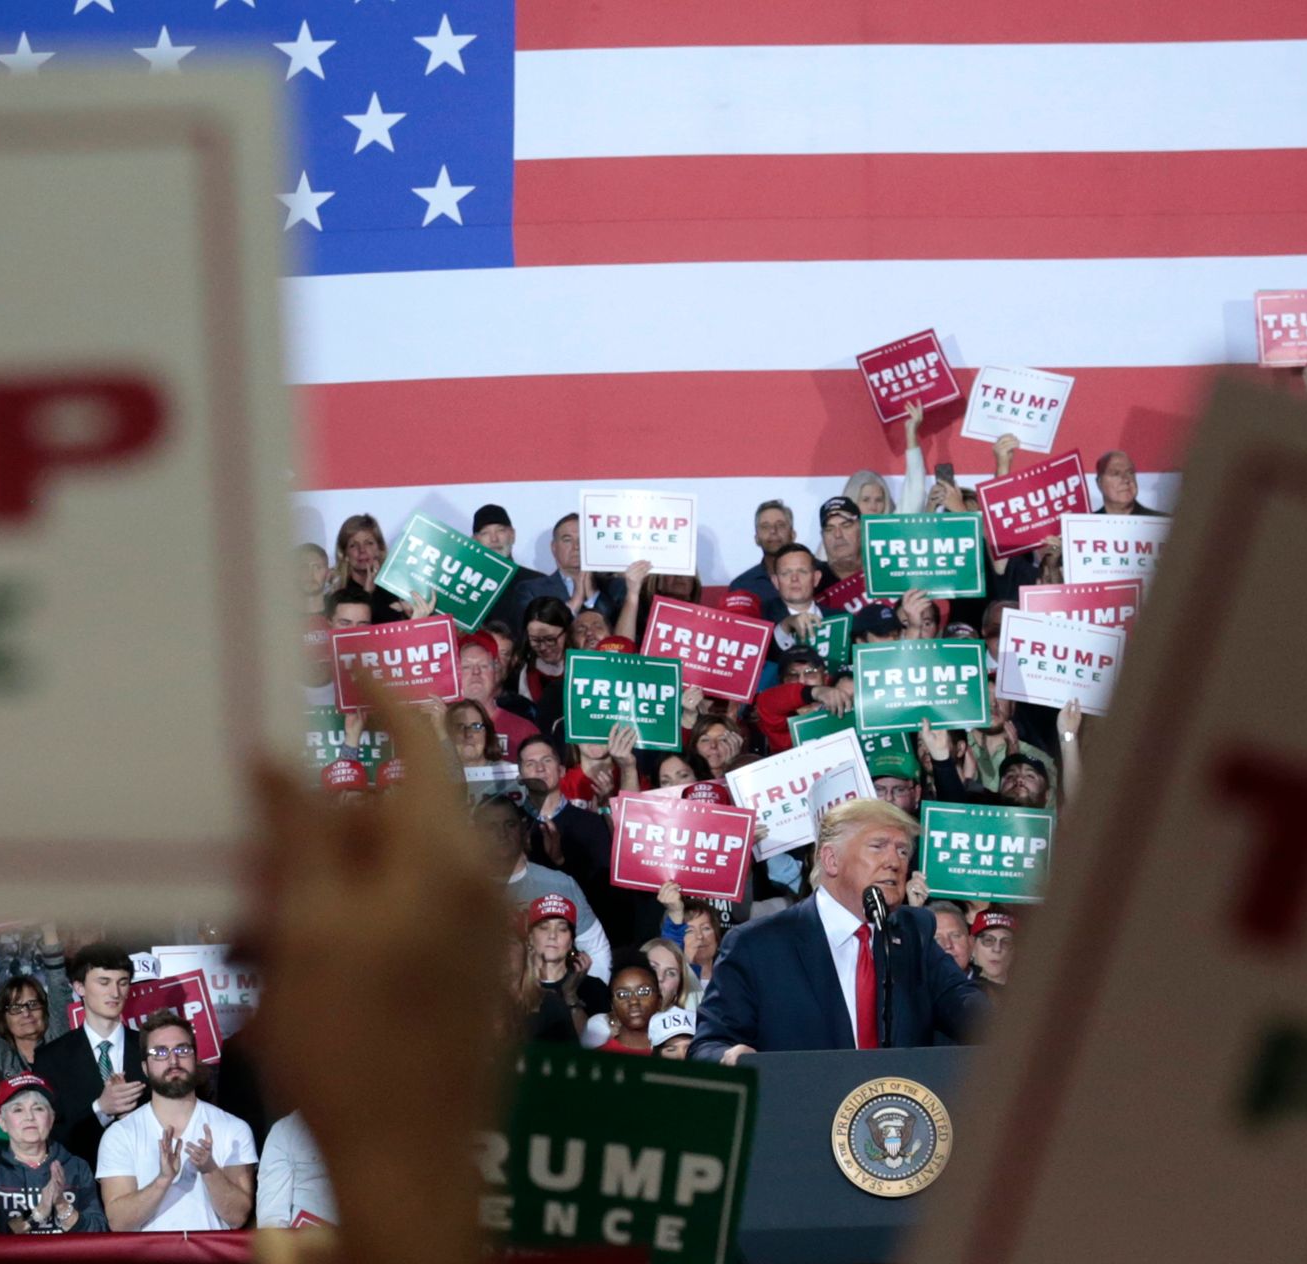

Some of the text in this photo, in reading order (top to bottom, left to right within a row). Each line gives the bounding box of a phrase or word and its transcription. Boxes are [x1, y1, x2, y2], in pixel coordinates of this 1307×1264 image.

[868, 351, 940, 388] TRUMP
[879, 367, 940, 398] PENCE
[980, 383, 1060, 412] TRUMP
[981, 400, 1048, 423] PENCE
[989, 474, 1082, 519] TRUMP
[588, 514, 689, 531] TRUMP
[1002, 493, 1078, 529] PENCE
[596, 531, 678, 543] PENCE
[870, 537, 975, 556] TRUMP
[1073, 540, 1164, 555] TRUM
[406, 534, 499, 593] TRUMP
[879, 555, 966, 568] PENCE
[1082, 556, 1148, 567] PENC
[405, 555, 482, 602] PENCE
[655, 621, 760, 659] TRUMP
[339, 642, 450, 669] TRUMP
[660, 641, 746, 671] PENCE
[1010, 637, 1115, 669] TRUMP
[863, 664, 979, 687] TRUMP
[1017, 657, 1102, 682] PENCE
[572, 677, 676, 701] TRUMP
[873, 683, 969, 700] PENCE
[580, 698, 667, 716] PENCE
[625, 821, 743, 853] TRUMP
[929, 830, 1047, 855] TRUMP
[631, 842, 729, 867] PENCE
[937, 851, 1035, 869] PENCE
[691, 866, 716, 875] GREAT!
[967, 868, 999, 877] AMERICA
[662, 1013, 692, 1030] USA
[890, 1082, 900, 1091] OF
[903, 1085, 920, 1095] THE
[836, 1082, 887, 1136] PRESIDENT
[921, 1094, 949, 1142] UNITED
[473, 1133, 726, 1206] RUMP
[854, 1168, 885, 1192] SEAL
[905, 1152, 945, 1191] STATES
[0, 1191, 76, 1211] TRUP
[478, 1196, 688, 1252] ENCE
